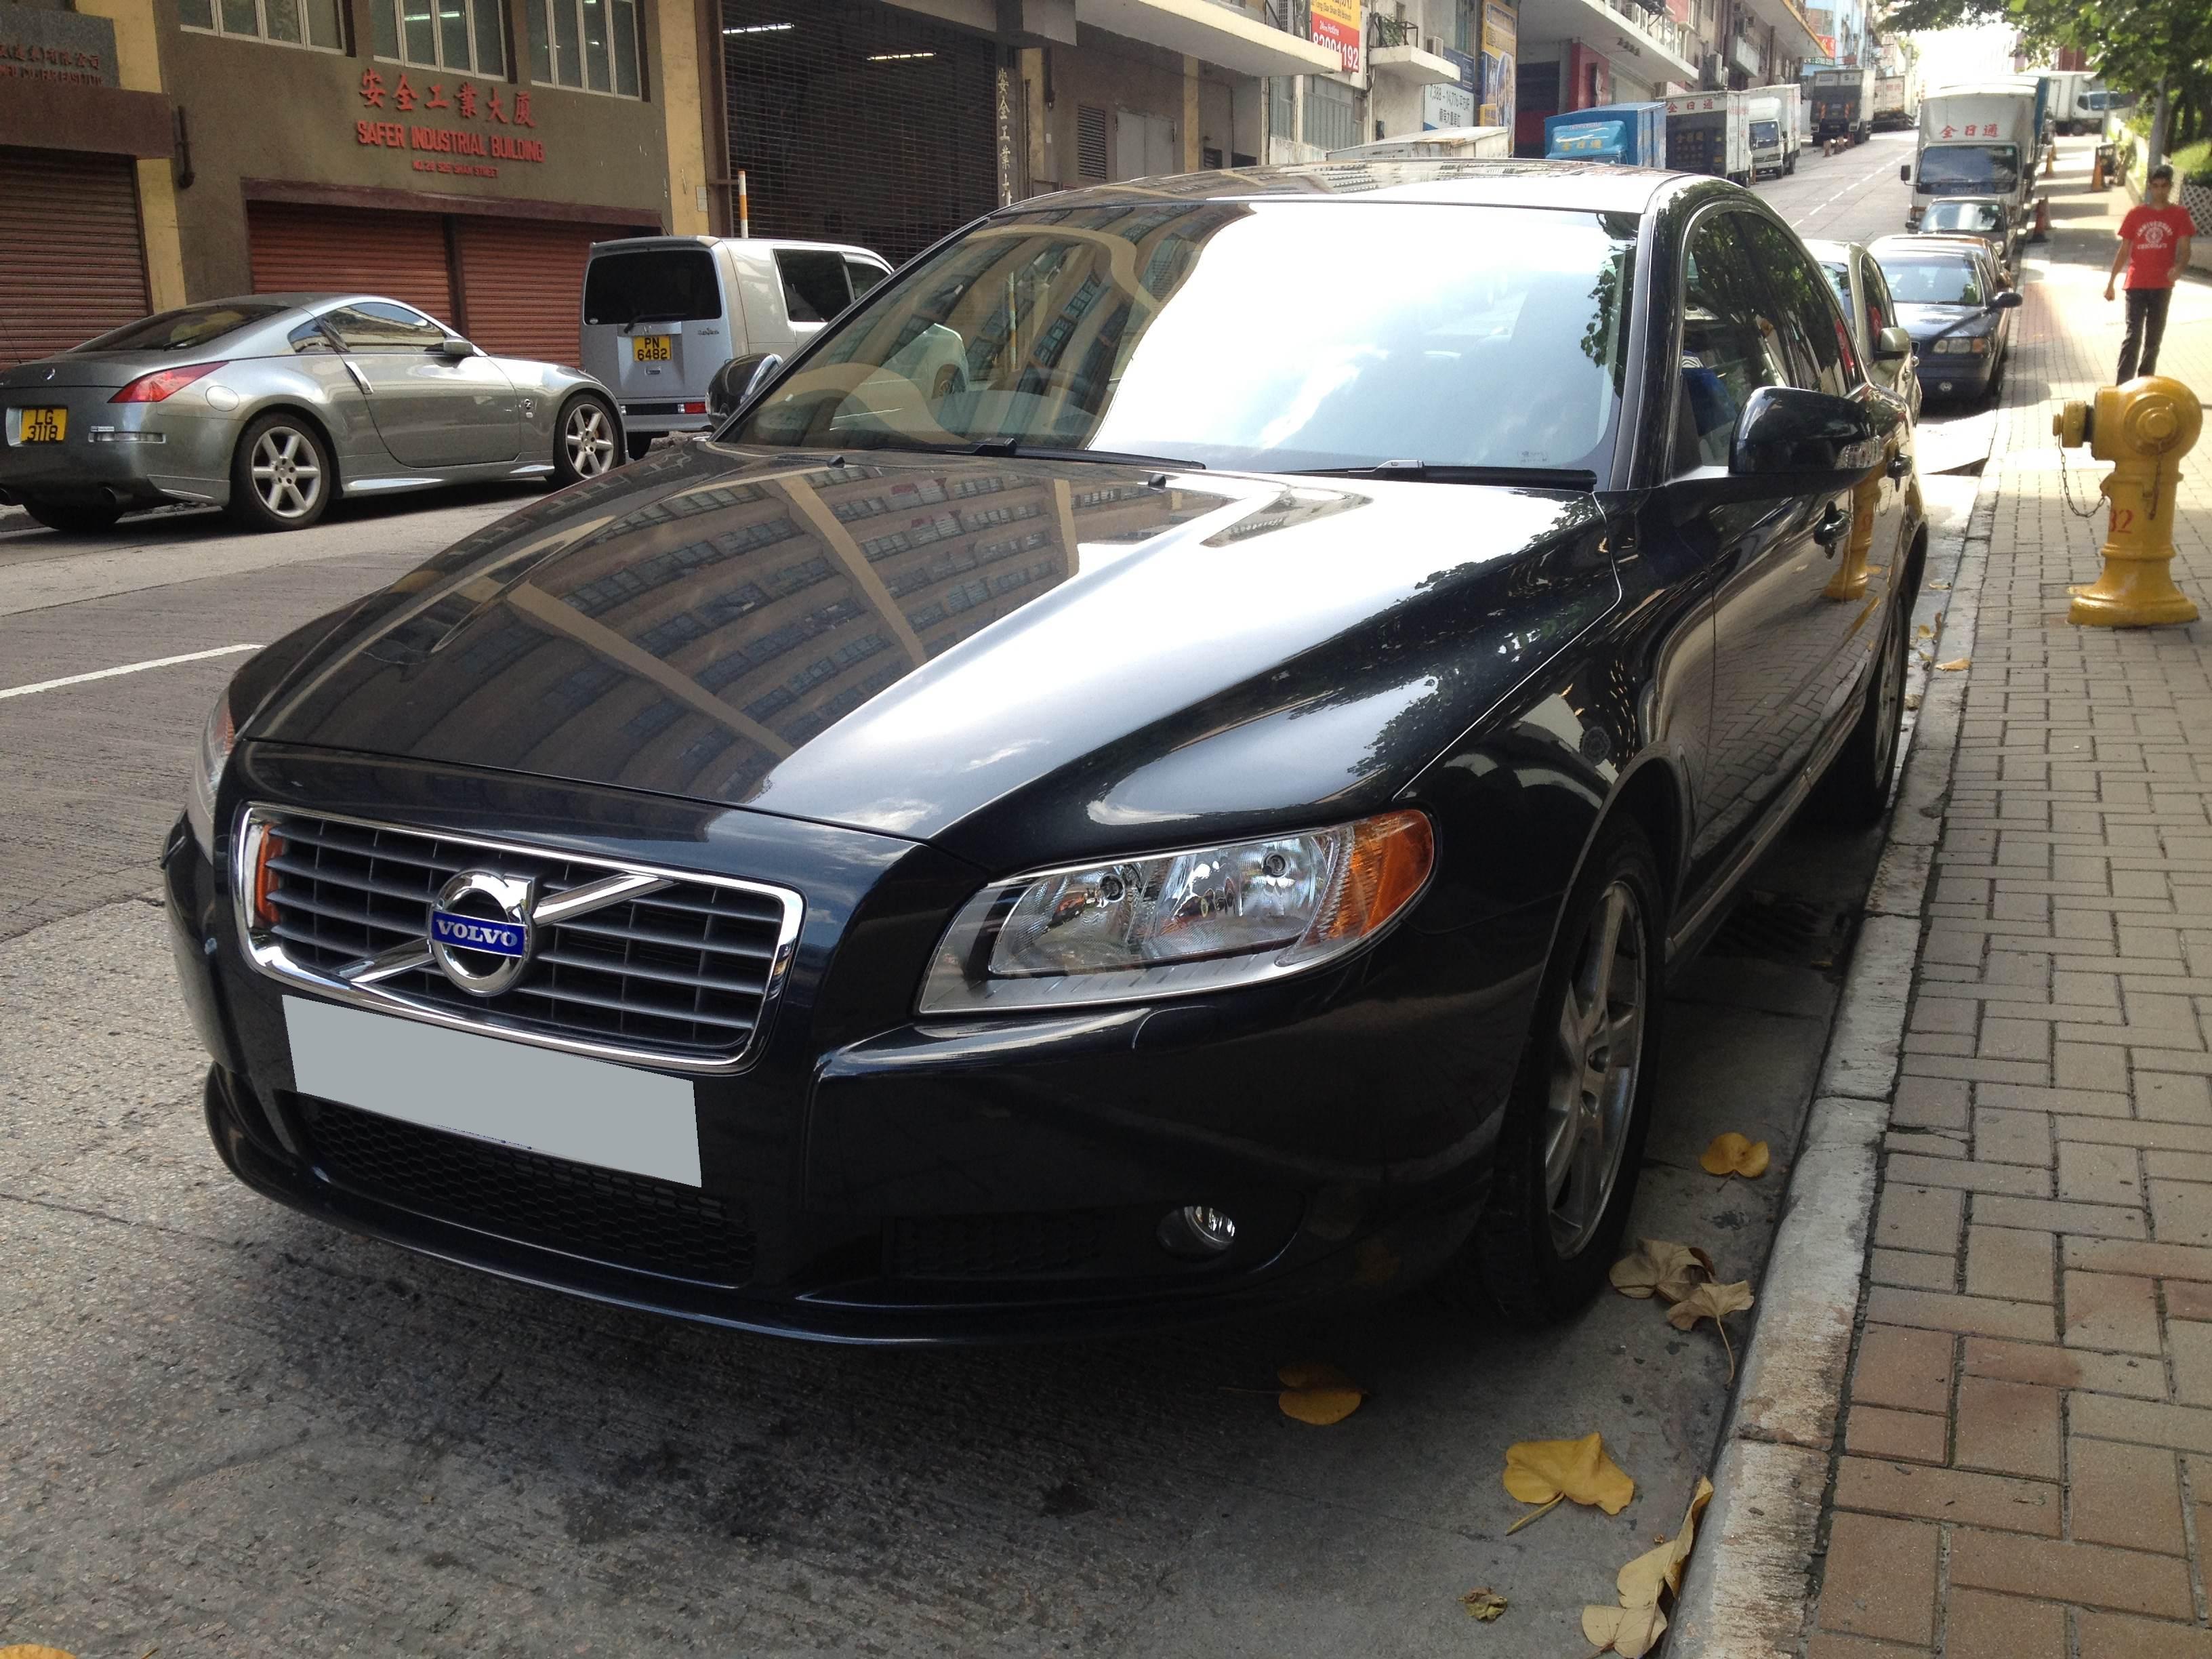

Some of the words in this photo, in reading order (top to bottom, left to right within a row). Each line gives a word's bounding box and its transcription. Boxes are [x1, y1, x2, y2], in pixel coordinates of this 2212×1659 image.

[1666, 101, 1714, 113] 全日通
[1939, 123, 1999, 139] 全日通
[357, 119, 405, 148] SAFER
[411, 125, 487, 156] INDUSTRIAL
[491, 136, 546, 163] BUILDING
[473, 165, 499, 178] STREET
[644, 338, 659, 348] PN
[638, 348, 668, 361] 6482
[35, 409, 54, 425] LG
[27, 426, 58, 441] 3118
[436, 920, 518, 947] VOLVO
